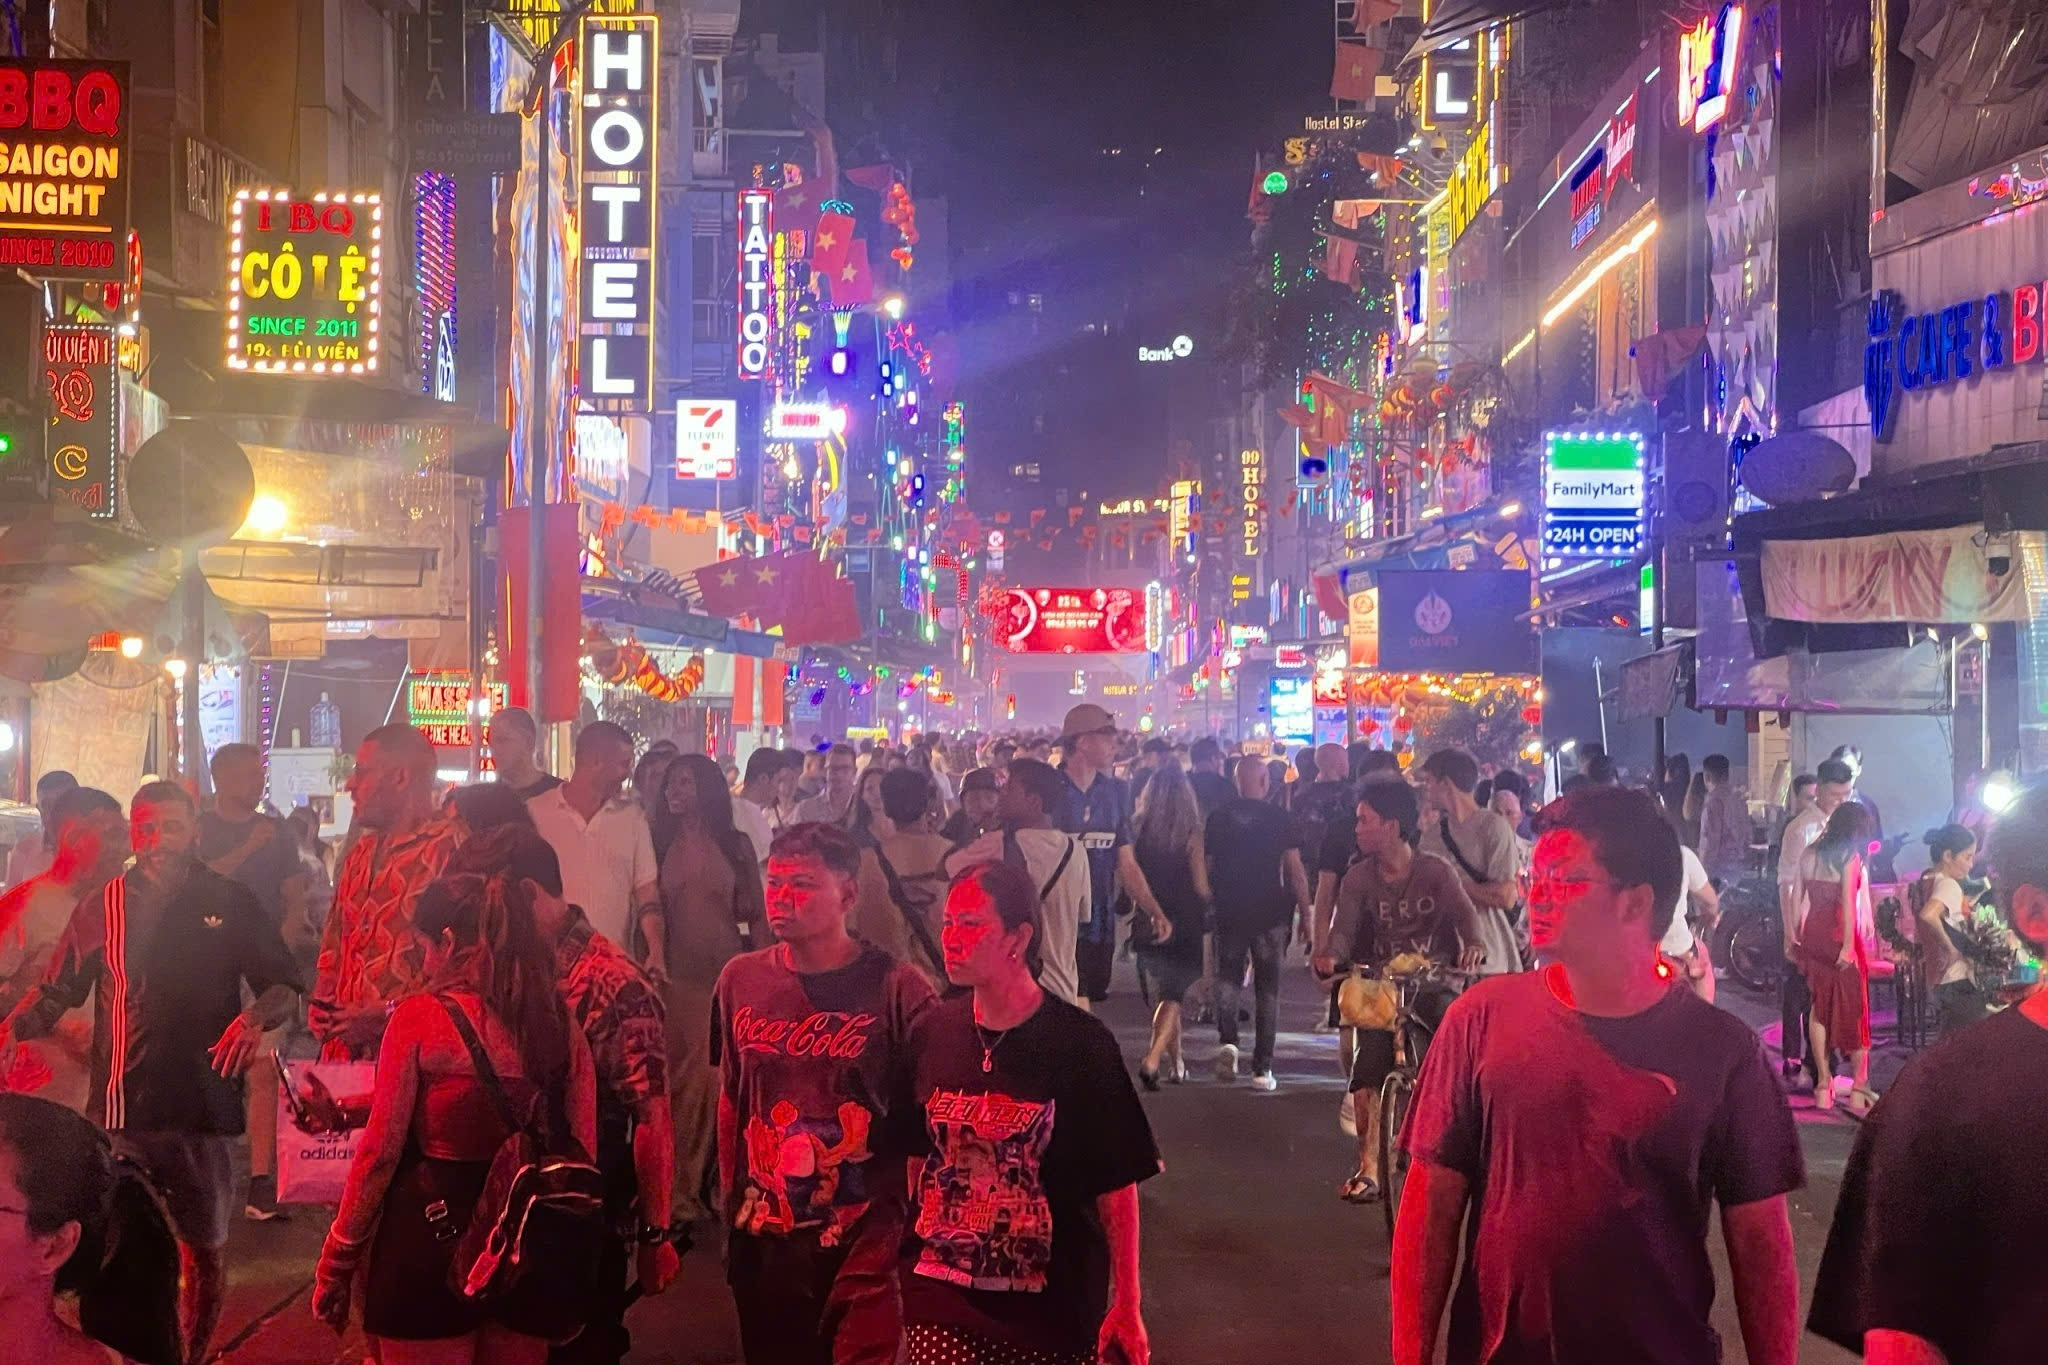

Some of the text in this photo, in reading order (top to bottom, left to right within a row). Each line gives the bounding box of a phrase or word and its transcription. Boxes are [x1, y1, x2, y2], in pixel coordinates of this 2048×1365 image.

[0, 68, 121, 137] BBQ
[1305, 116, 1339, 130] Hostel
[0, 182, 105, 216] NIGHT
[590, 33, 643, 393] HOTEL
[61, 241, 114, 268] 2010
[241, 241, 301, 300] CÔ
[742, 195, 768, 372] TATTOO
[315, 319, 357, 338] 2011
[1897, 280, 2048, 392] CAFE & B
[1139, 348, 1173, 361] Bank
[1553, 483, 1635, 499] FamilyMart
[1243, 468, 1258, 555] HOTEL
[1553, 528, 1634, 543] 24H OPEN
[414, 686, 503, 711] MASSE
